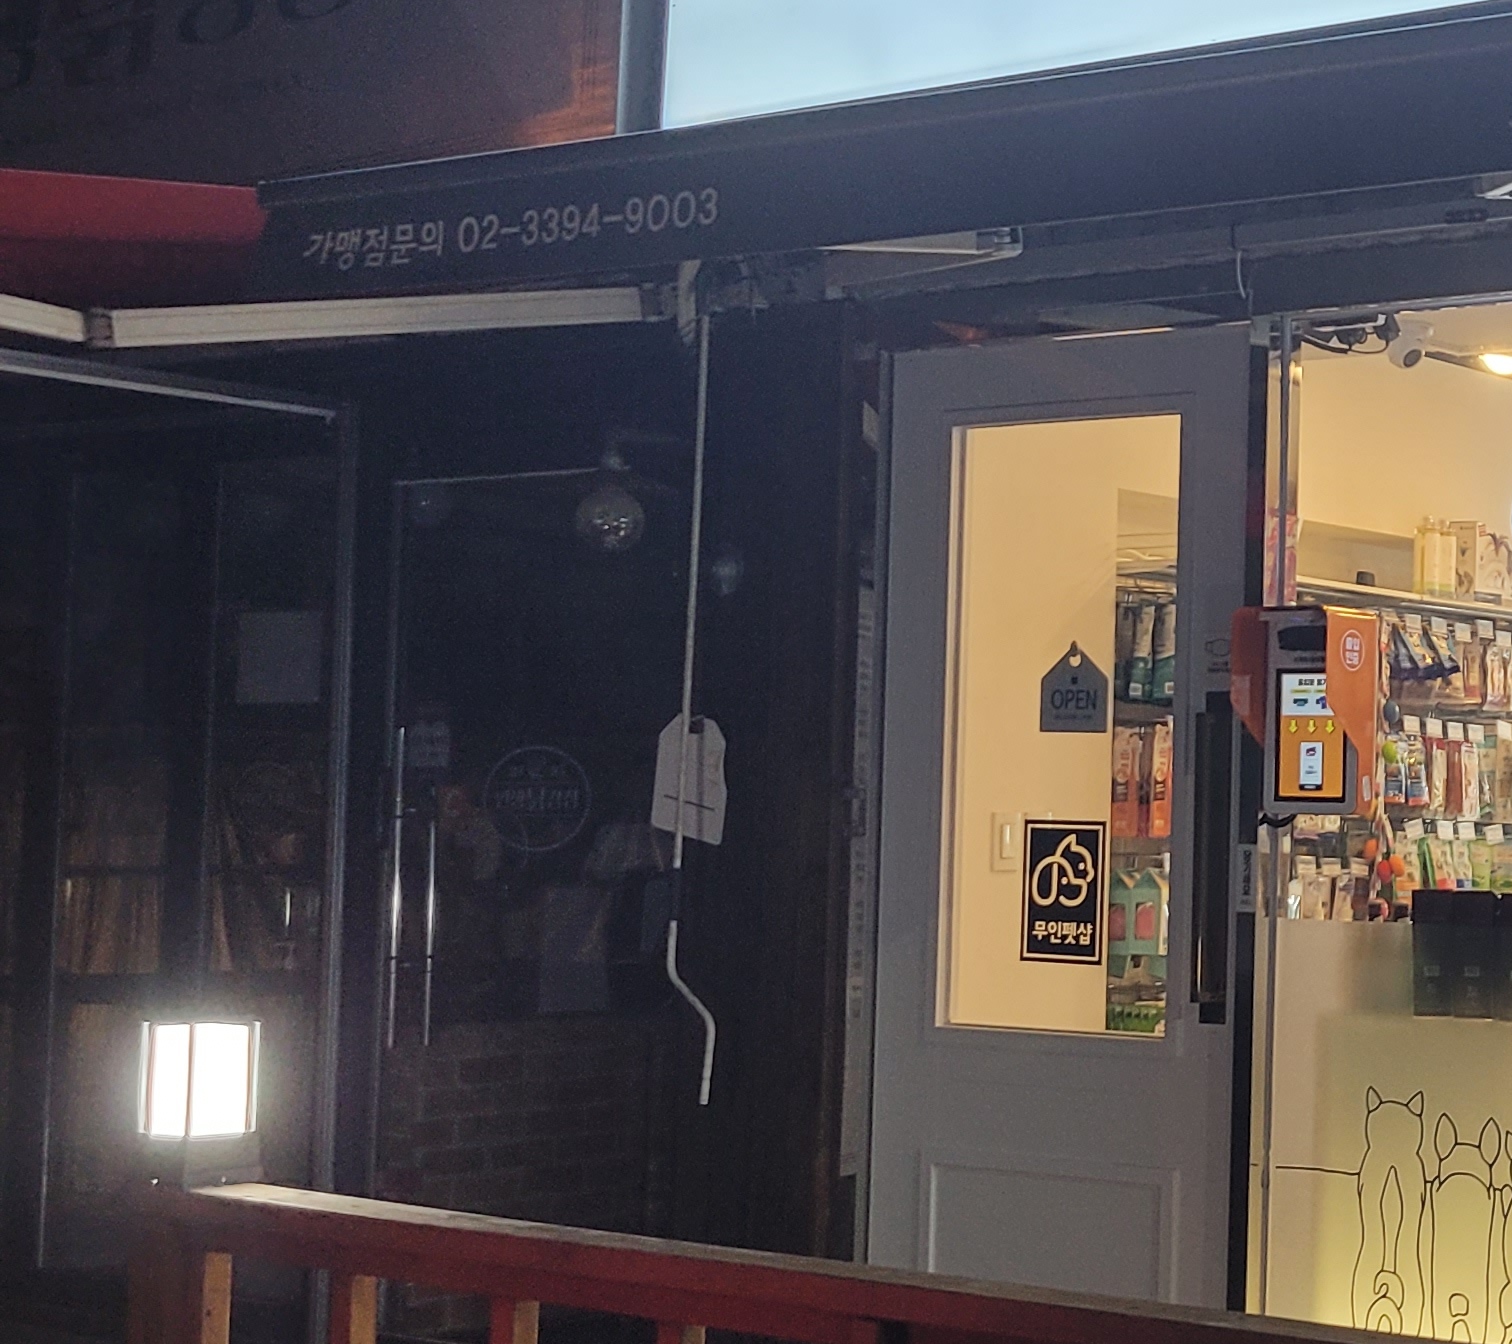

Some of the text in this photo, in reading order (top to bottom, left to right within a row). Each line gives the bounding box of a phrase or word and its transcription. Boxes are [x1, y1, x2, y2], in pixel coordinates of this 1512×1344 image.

[304, 186, 719, 271] 가맹점문의 02-3394-9003
[1051, 689, 1097, 710] OPEN
[1032, 921, 1094, 946] 무인펫샵
